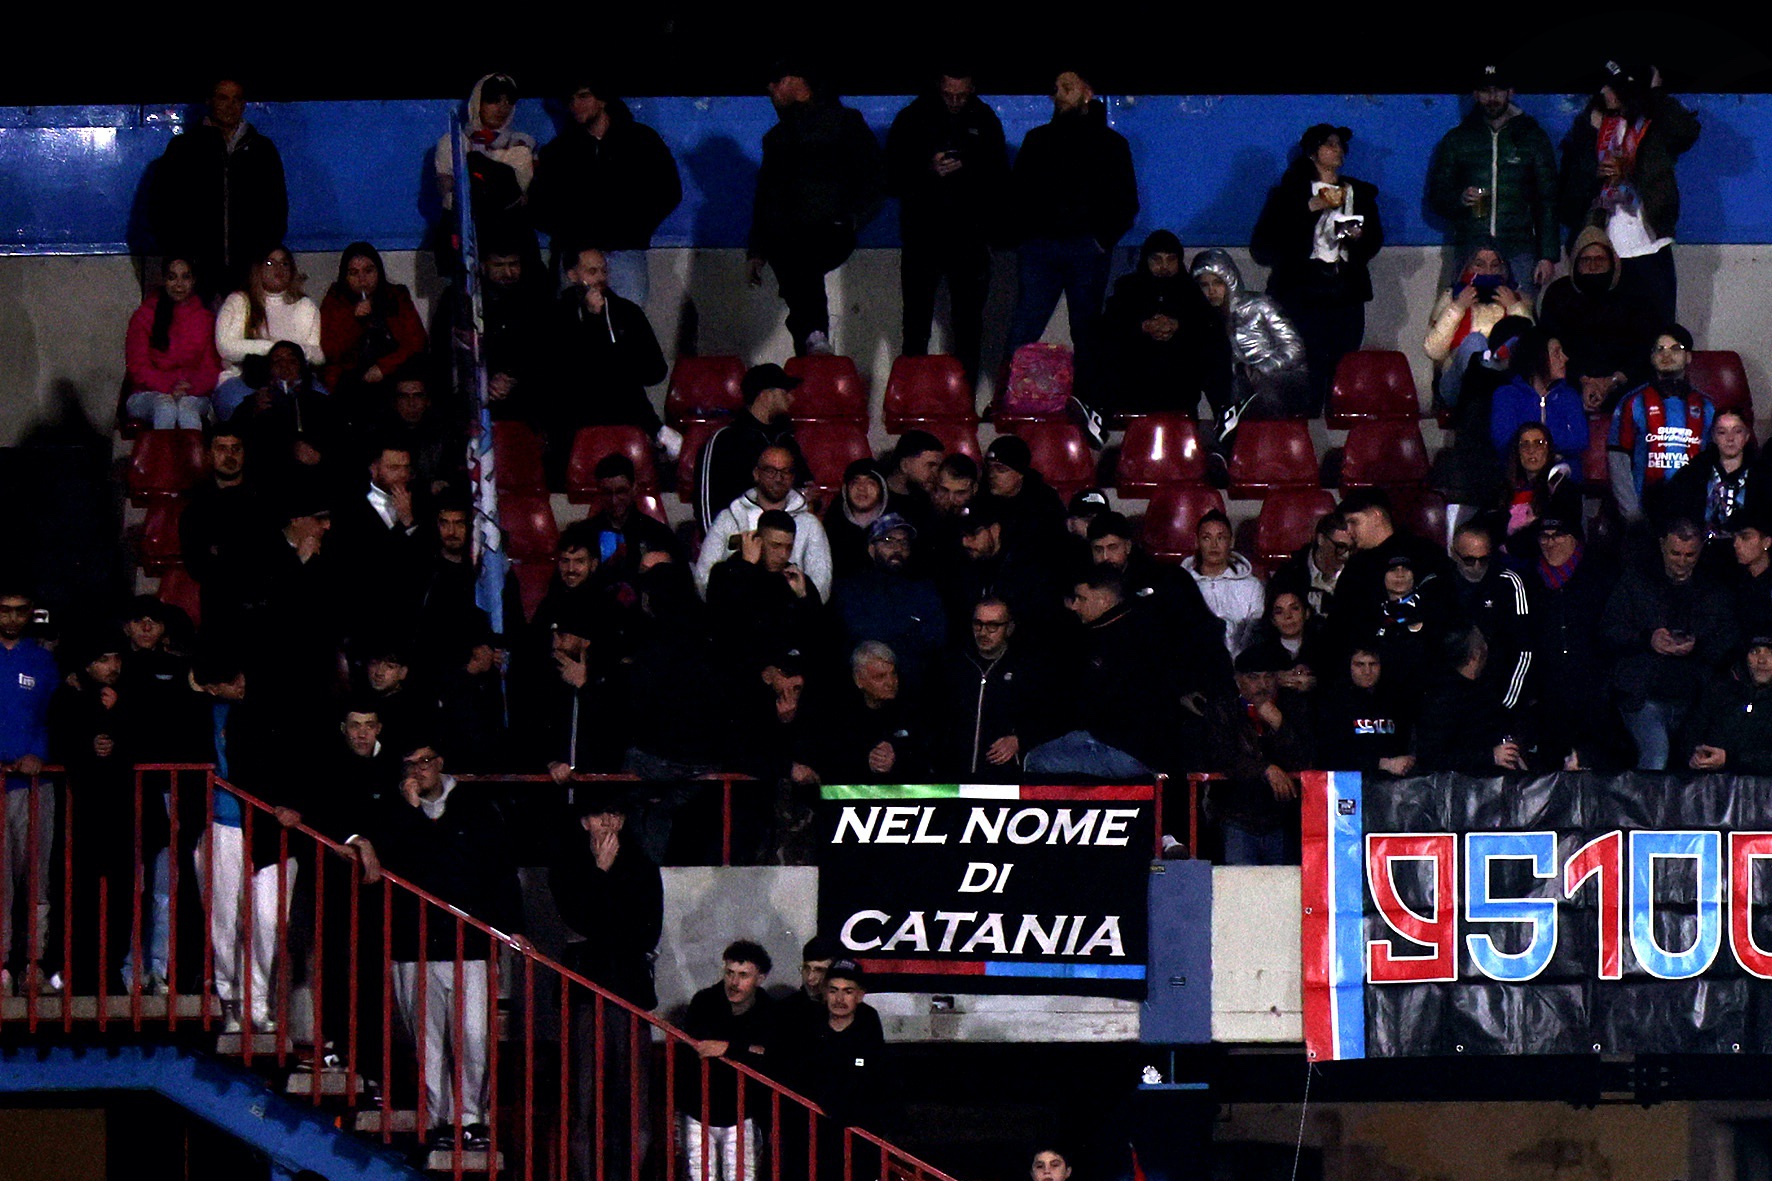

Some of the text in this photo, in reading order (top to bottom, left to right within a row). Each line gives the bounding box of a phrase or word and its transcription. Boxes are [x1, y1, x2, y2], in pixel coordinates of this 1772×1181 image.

[832, 805, 1140, 847] NEL NOME
[958, 862, 1014, 894] DI
[839, 908, 1126, 957] CATANIA
